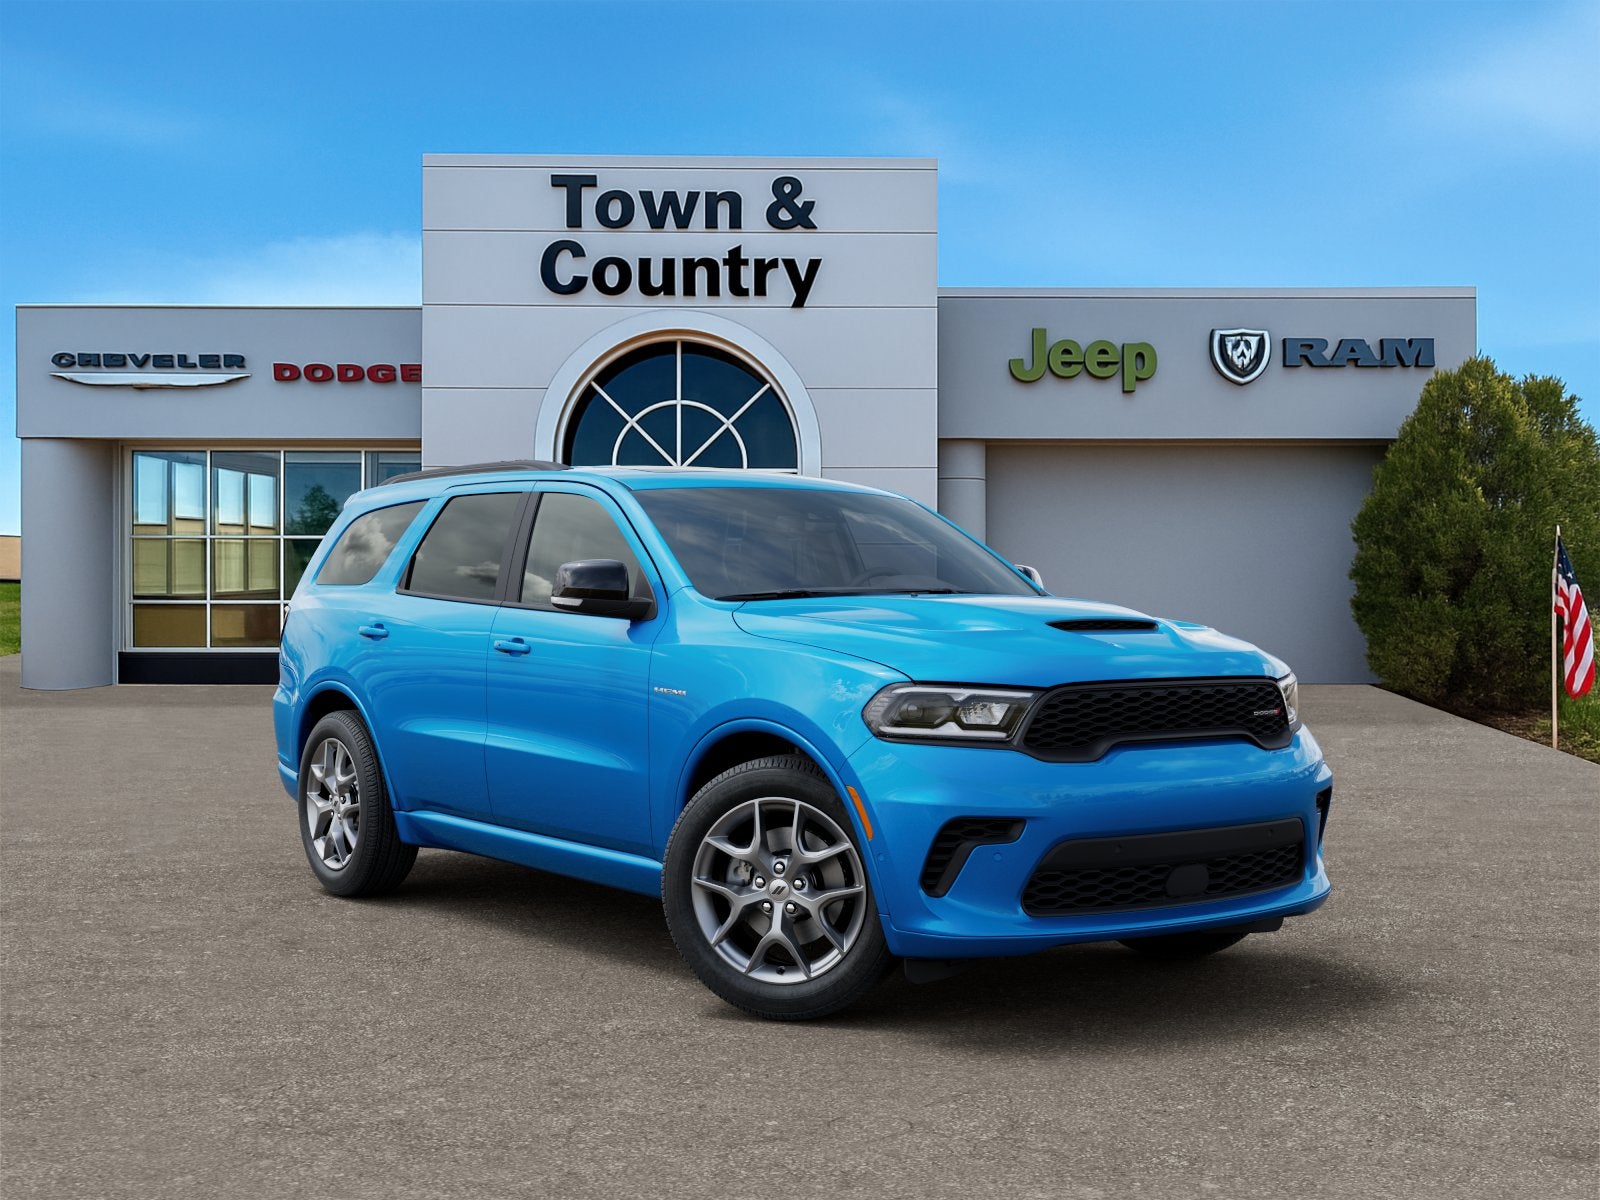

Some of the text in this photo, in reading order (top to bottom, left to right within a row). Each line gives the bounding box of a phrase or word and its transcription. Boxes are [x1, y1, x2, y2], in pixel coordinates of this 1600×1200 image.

[550, 173, 818, 230] Town &
[539, 238, 822, 309] Country
[273, 362, 422, 384] DODGE
[1008, 327, 1158, 393] Jeep
[1282, 337, 1435, 368] RAM
